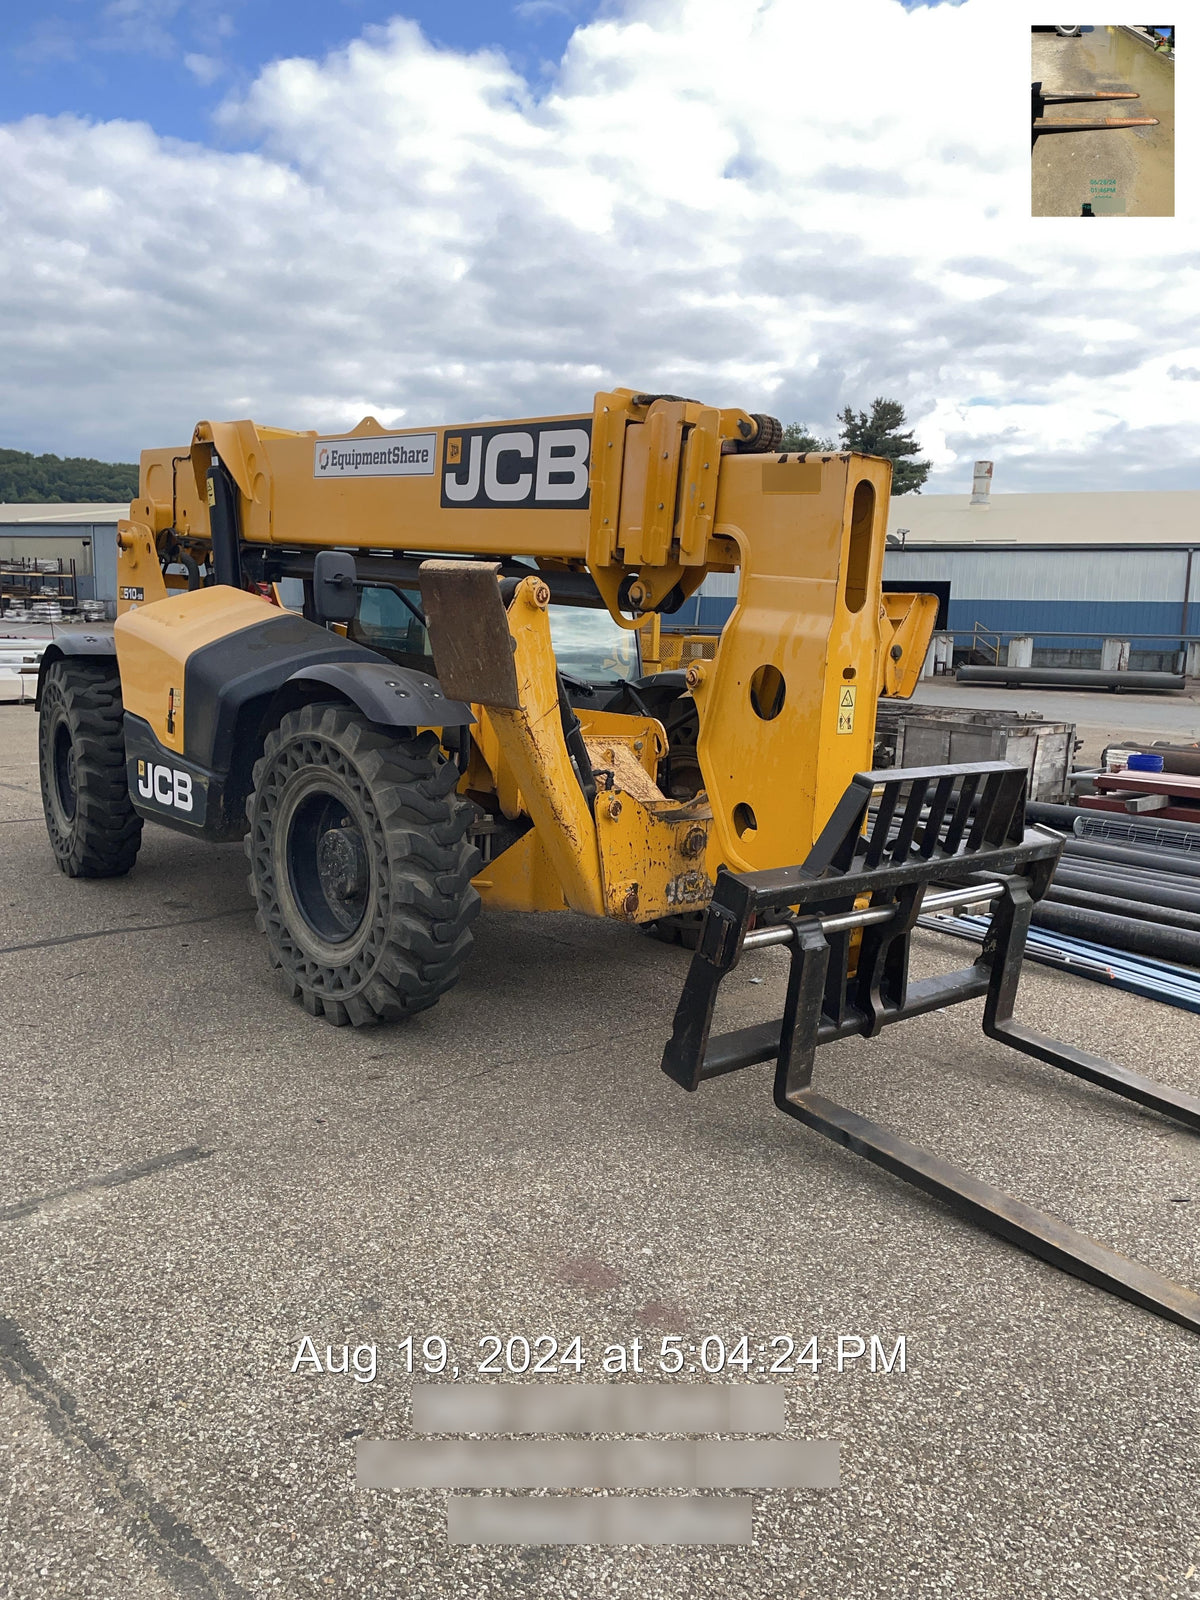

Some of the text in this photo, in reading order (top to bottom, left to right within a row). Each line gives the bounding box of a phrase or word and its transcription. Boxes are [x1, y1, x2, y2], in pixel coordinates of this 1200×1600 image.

[330, 446, 429, 470] EquipmentShare
[444, 428, 590, 502] JCB
[138, 762, 193, 812] JCB
